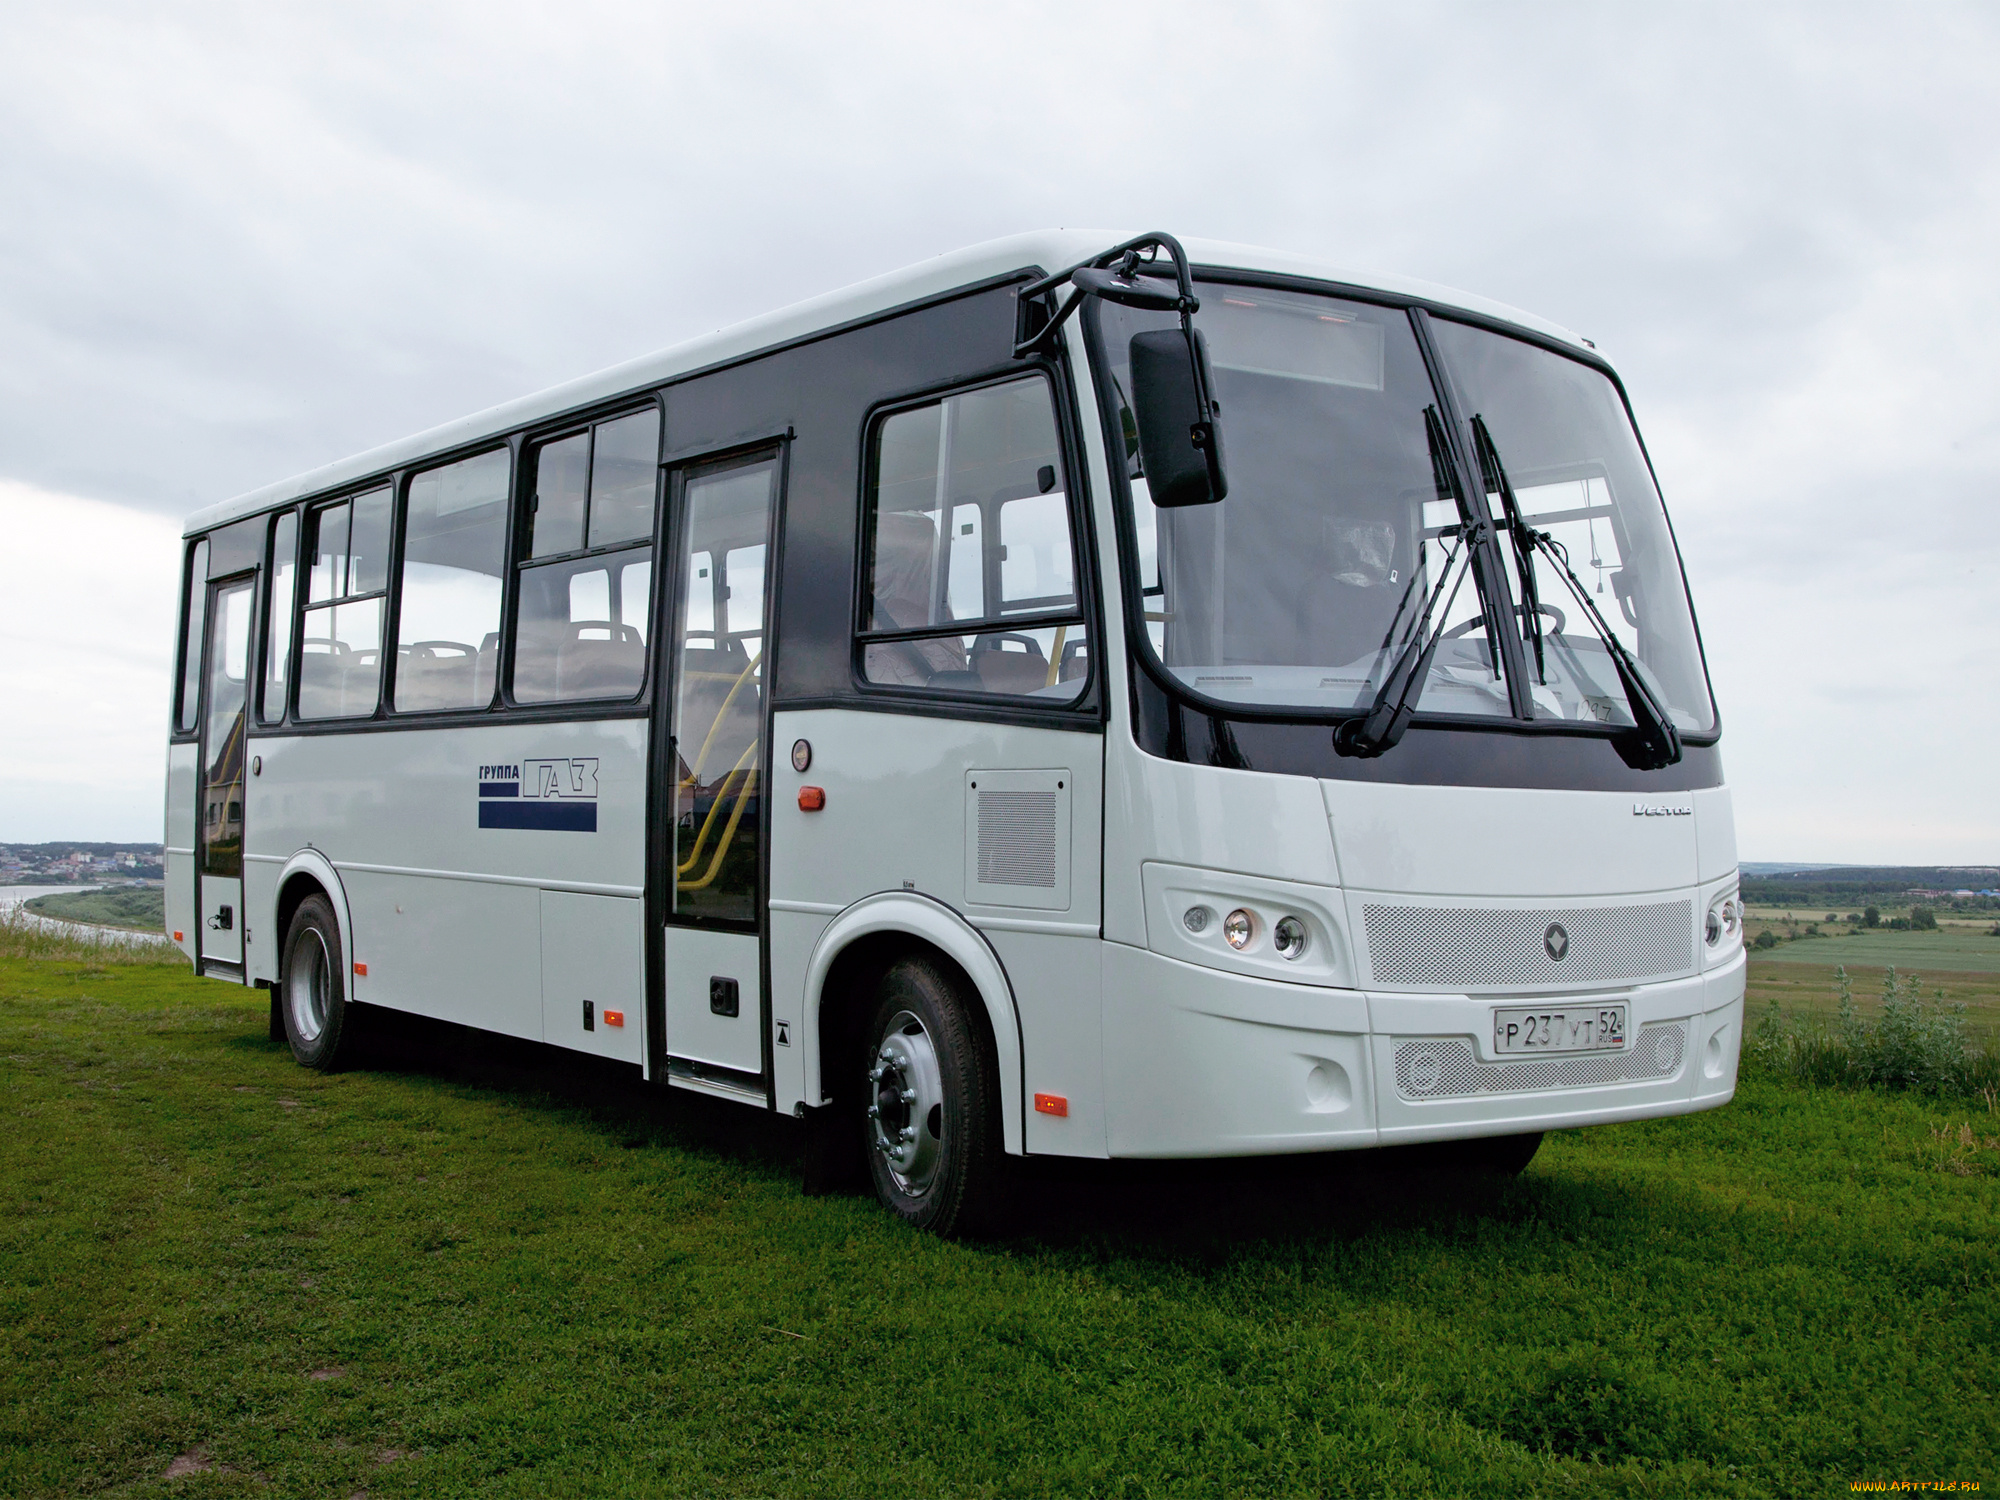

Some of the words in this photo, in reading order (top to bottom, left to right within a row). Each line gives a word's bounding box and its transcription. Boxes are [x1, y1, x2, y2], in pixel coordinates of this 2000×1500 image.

[479, 765, 519, 779] ГРУППА
[523, 758, 599, 798] ГАЗ
[1600, 1011, 1618, 1034] 52
[1599, 1034, 1613, 1043] RUS
